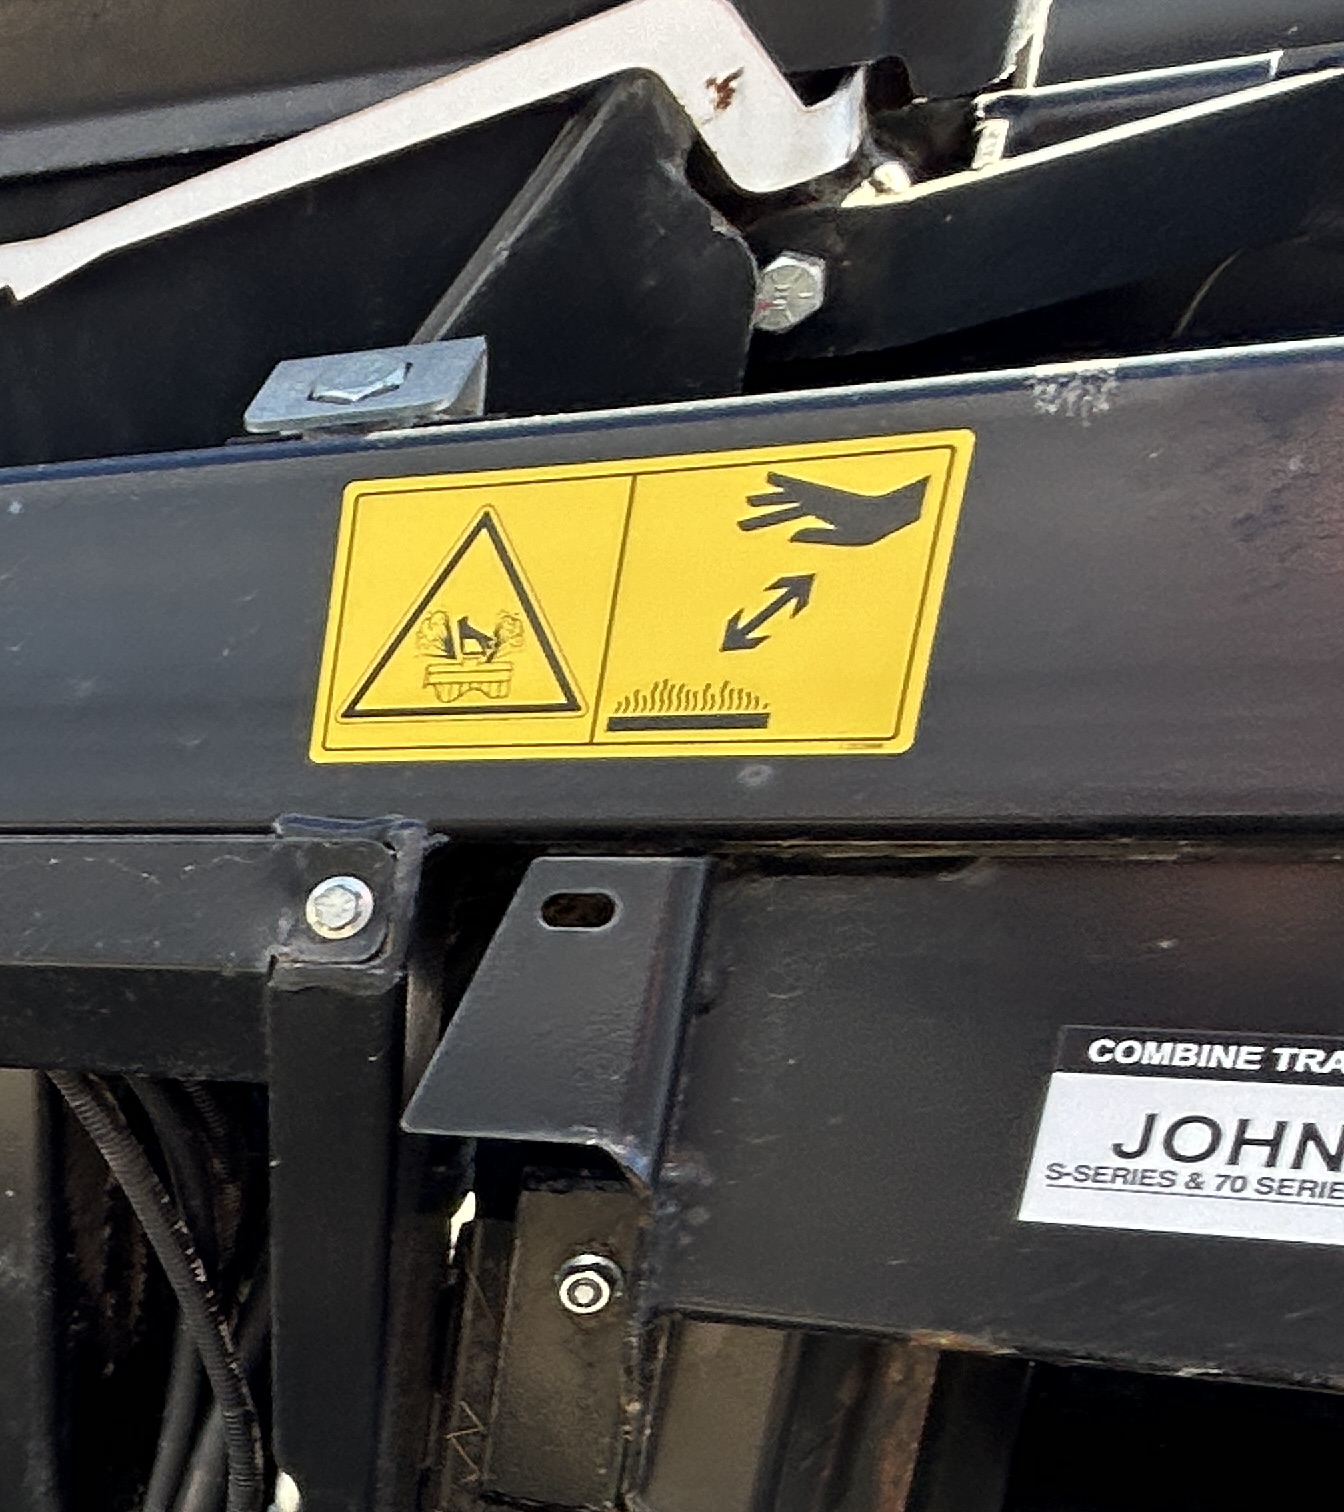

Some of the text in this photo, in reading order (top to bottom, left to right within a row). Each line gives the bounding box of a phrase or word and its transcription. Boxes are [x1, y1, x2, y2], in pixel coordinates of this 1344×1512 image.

[1086, 1037, 1266, 1071] COMBINE
[1110, 1111, 1344, 1172] JOHN
[1044, 1162, 1178, 1189] S-SERIES
[1184, 1172, 1206, 1191] &
[1214, 1173, 1248, 1194] 70
